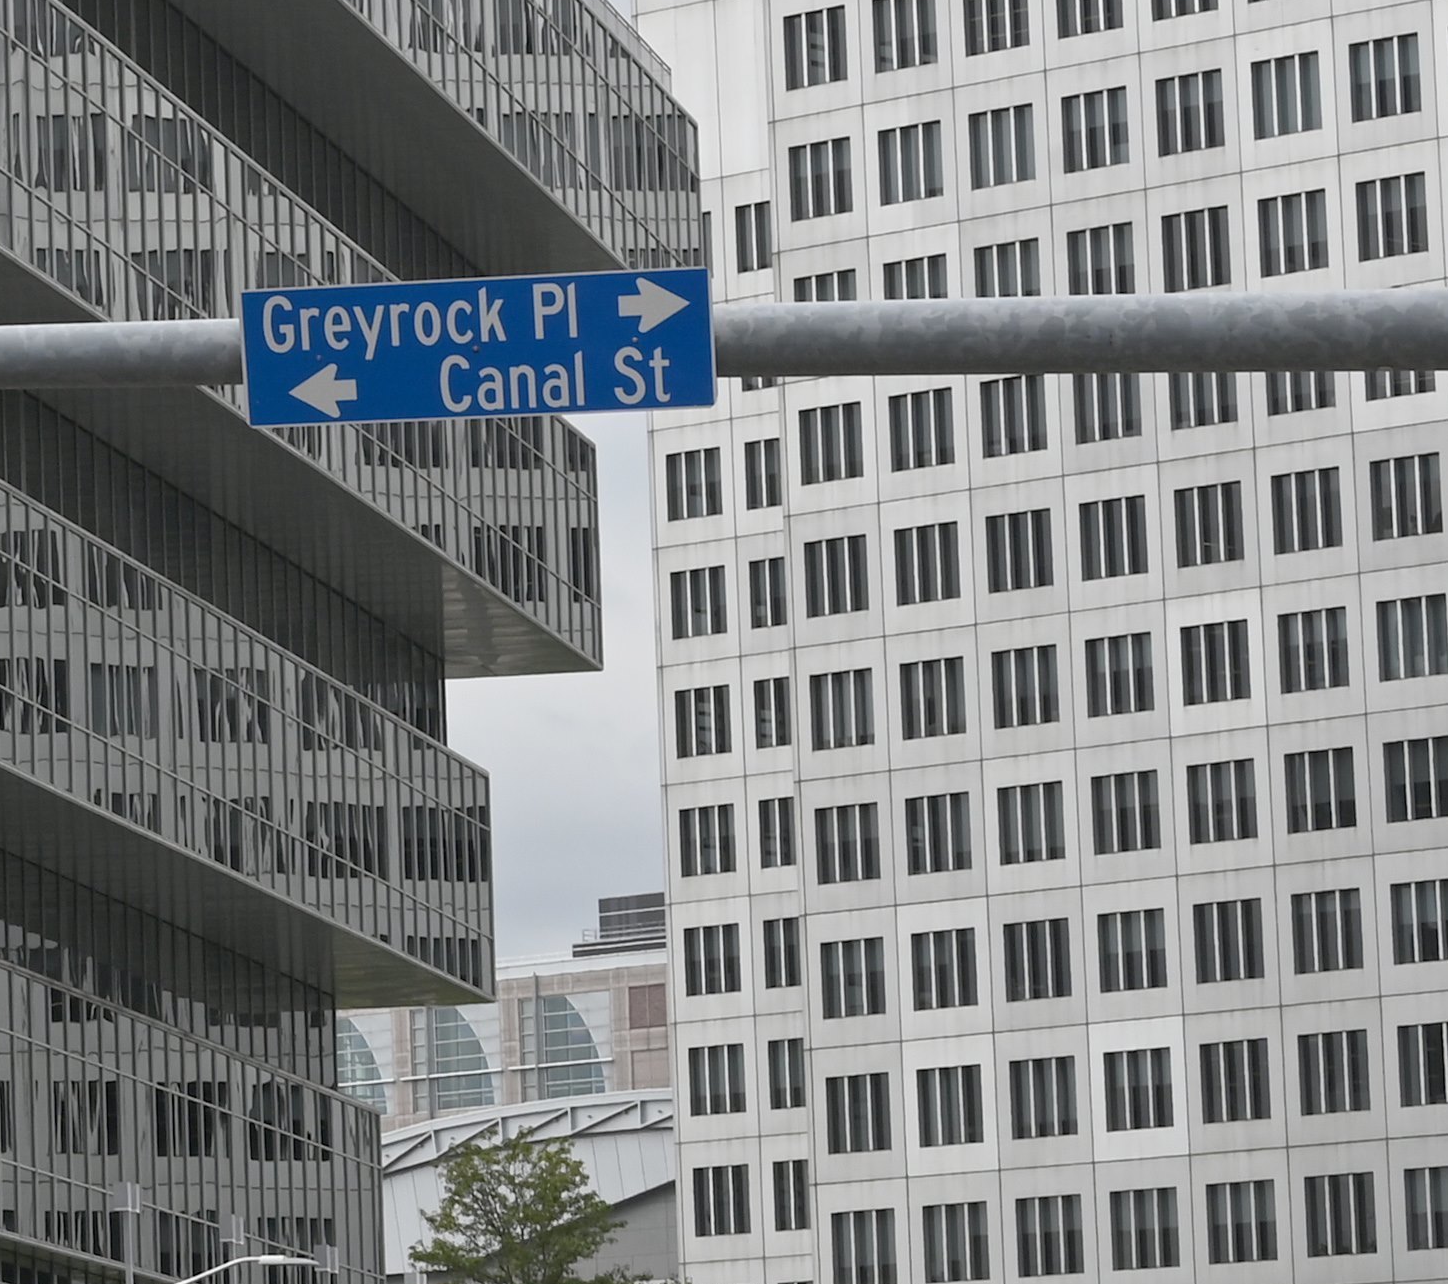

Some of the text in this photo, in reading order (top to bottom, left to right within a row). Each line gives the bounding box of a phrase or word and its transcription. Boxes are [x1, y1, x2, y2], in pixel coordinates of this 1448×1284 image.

[261, 282, 578, 361] Greyrock Pl
[439, 346, 671, 413] Canal St
